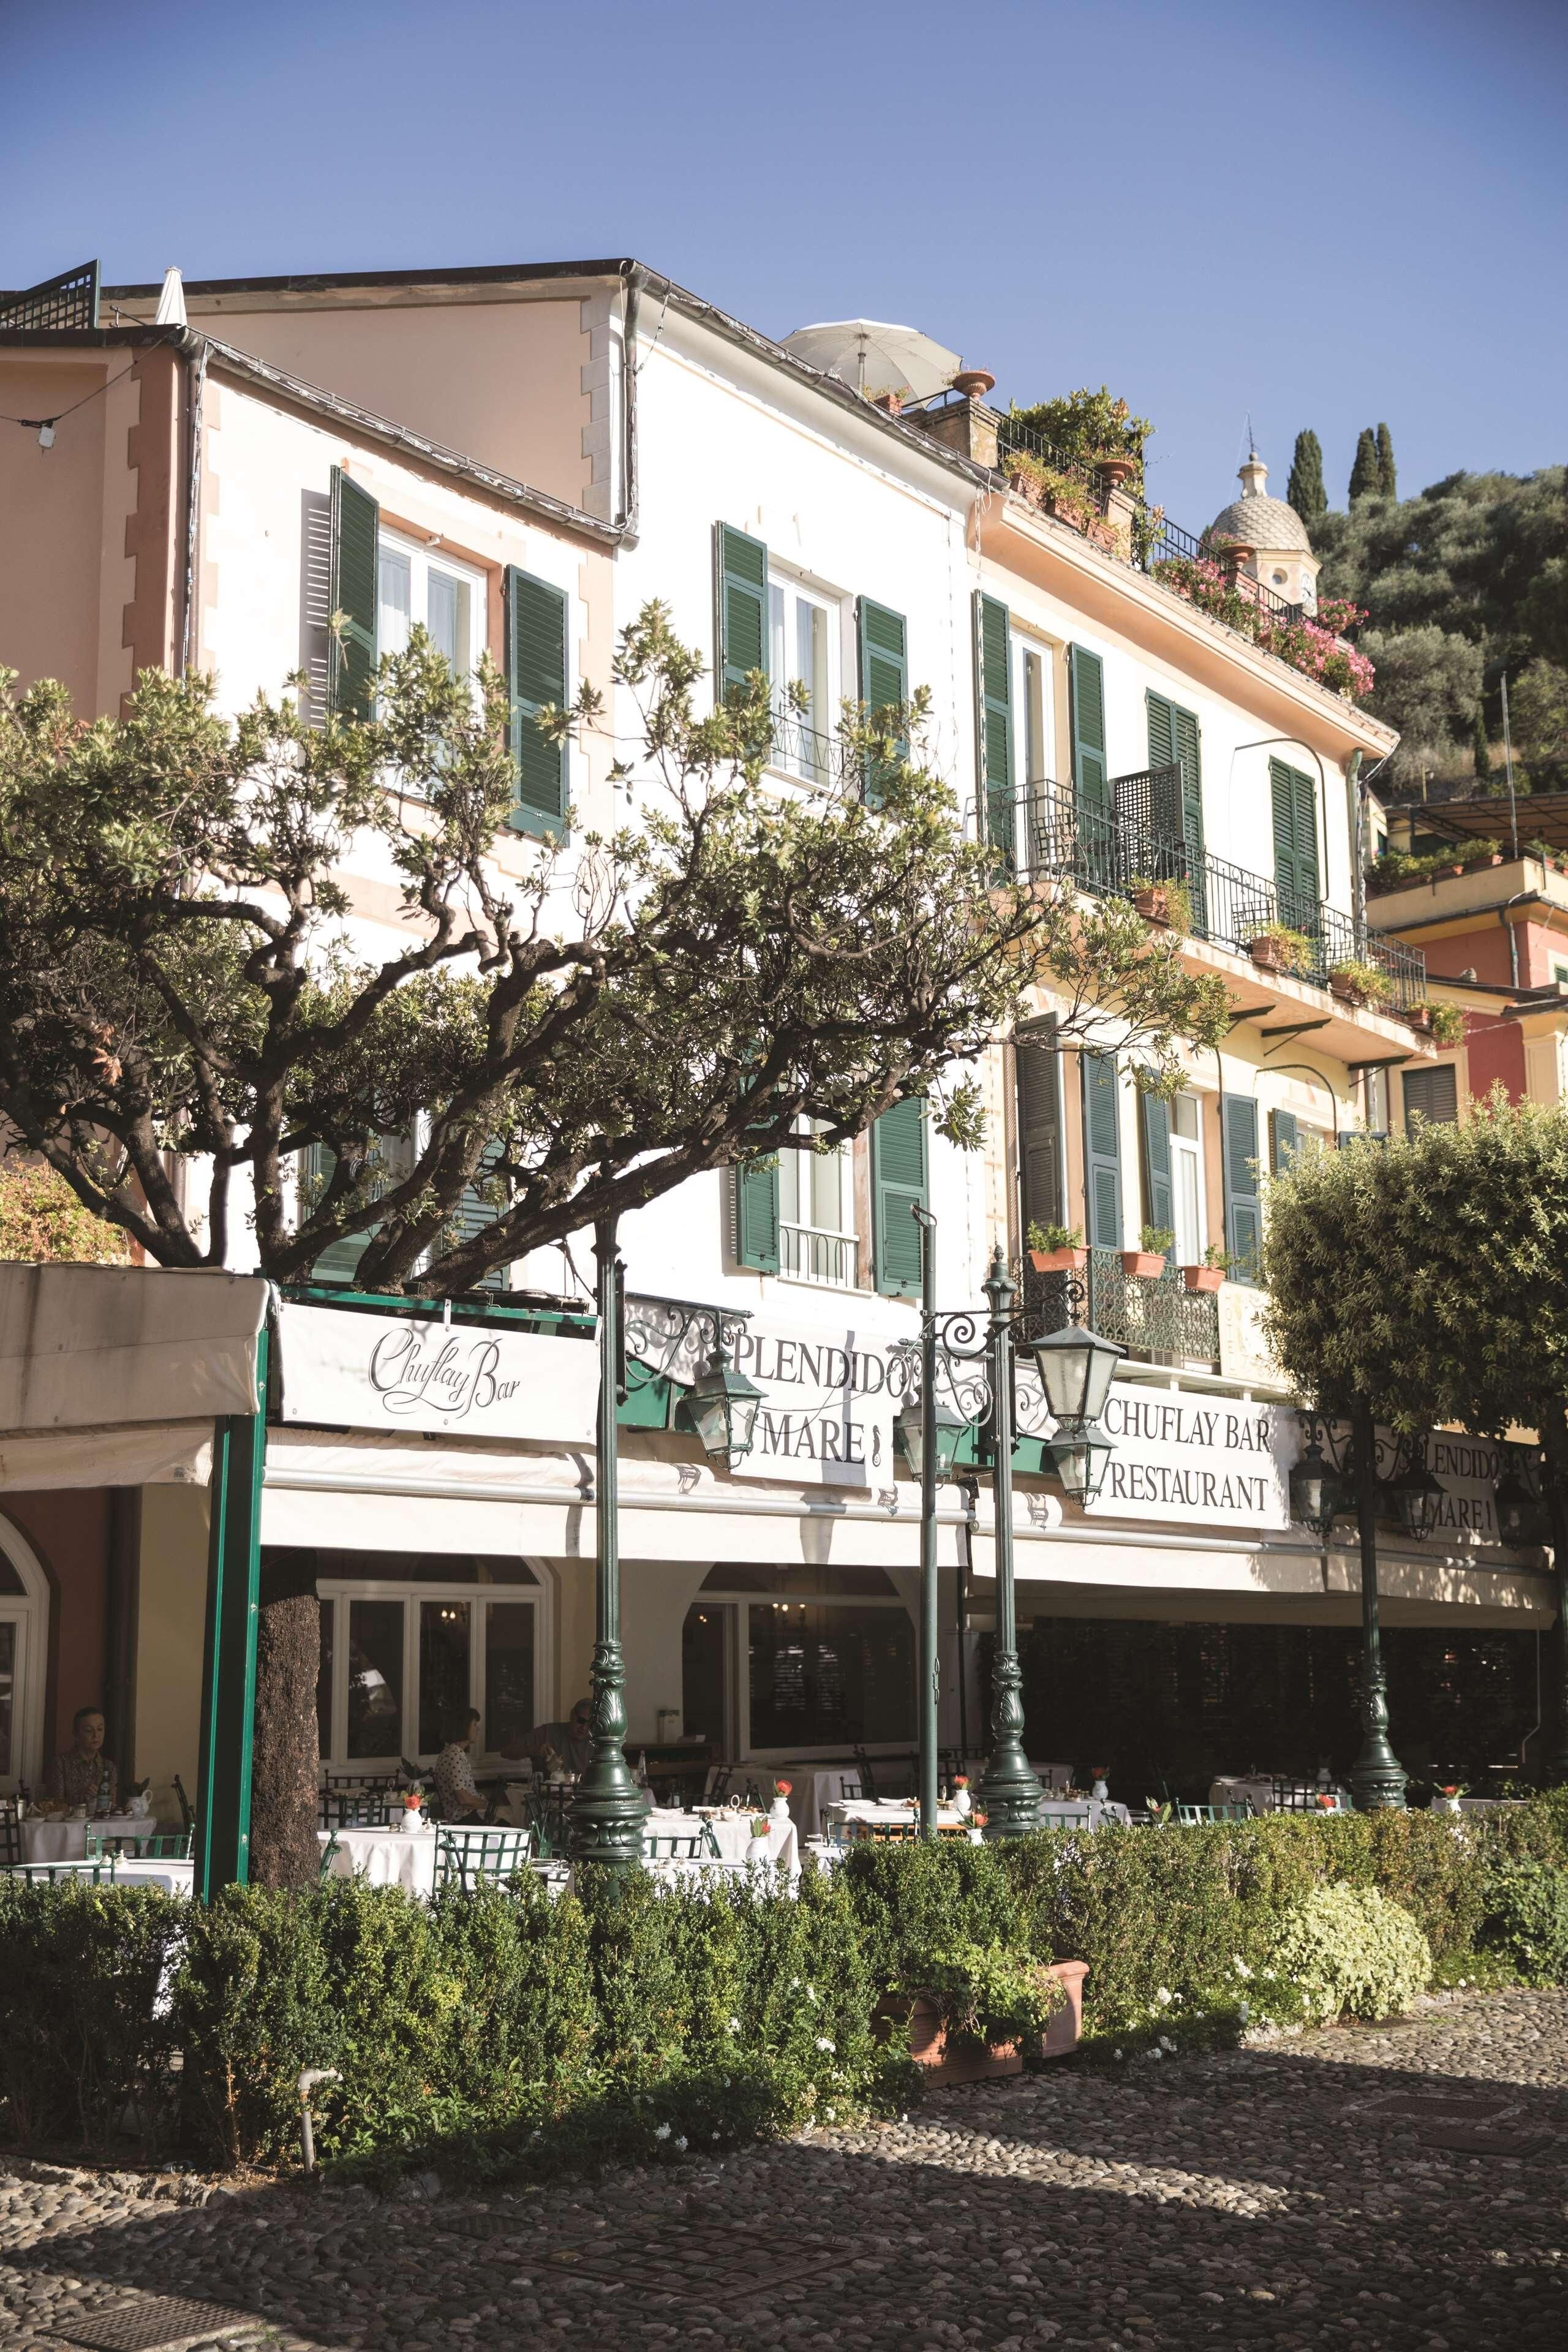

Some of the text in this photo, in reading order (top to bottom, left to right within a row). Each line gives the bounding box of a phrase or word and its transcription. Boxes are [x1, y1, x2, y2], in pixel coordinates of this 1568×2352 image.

[369, 1328, 521, 1419] Chuflay Bar
[734, 1332, 907, 1398] PLENDIDO
[761, 1412, 865, 1464] MARE
[1104, 1398, 1272, 1452] CHUFLAY BAR
[1108, 1461, 1268, 1511] RESTAURANT
[1425, 1439, 1499, 1480] LENDIDO
